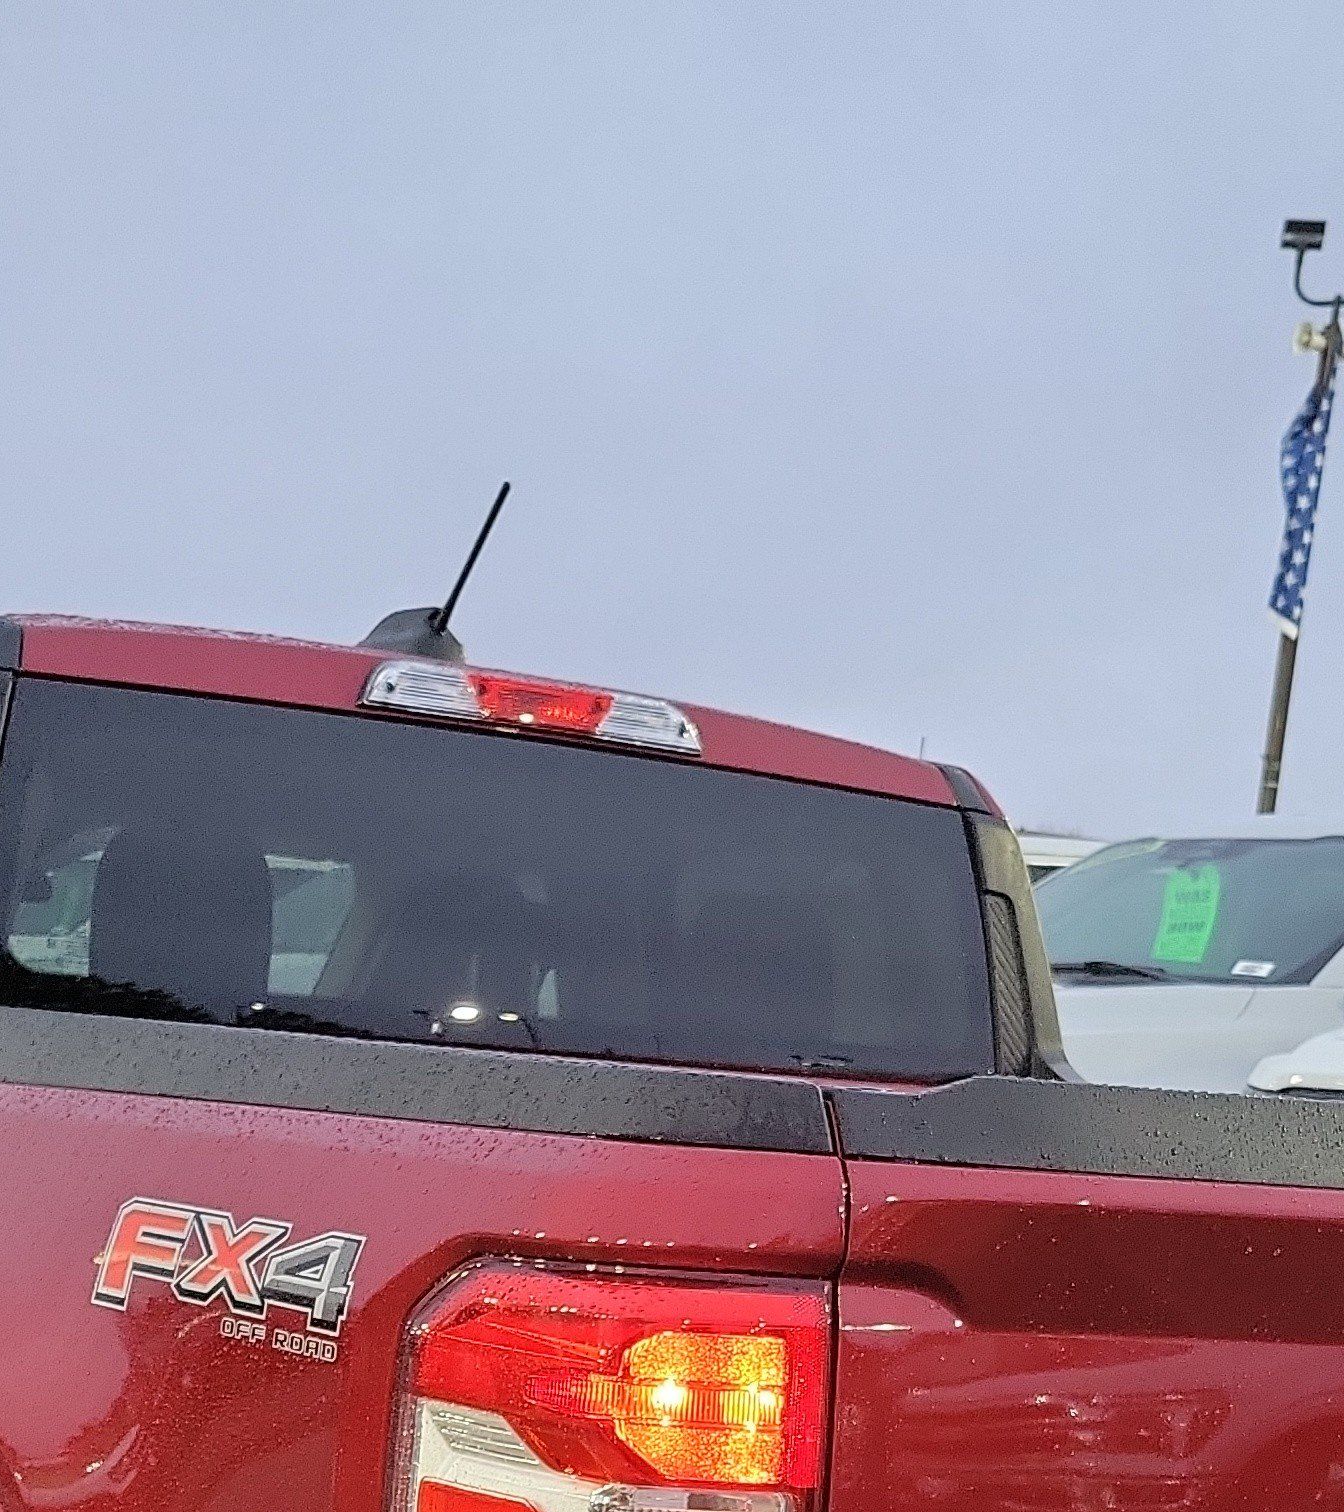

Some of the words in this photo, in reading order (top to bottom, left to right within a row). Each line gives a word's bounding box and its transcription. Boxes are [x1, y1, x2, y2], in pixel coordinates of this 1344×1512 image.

[91, 1197, 367, 1337] FX4
[220, 1317, 266, 1343] OFF
[271, 1330, 338, 1363] ROAD
